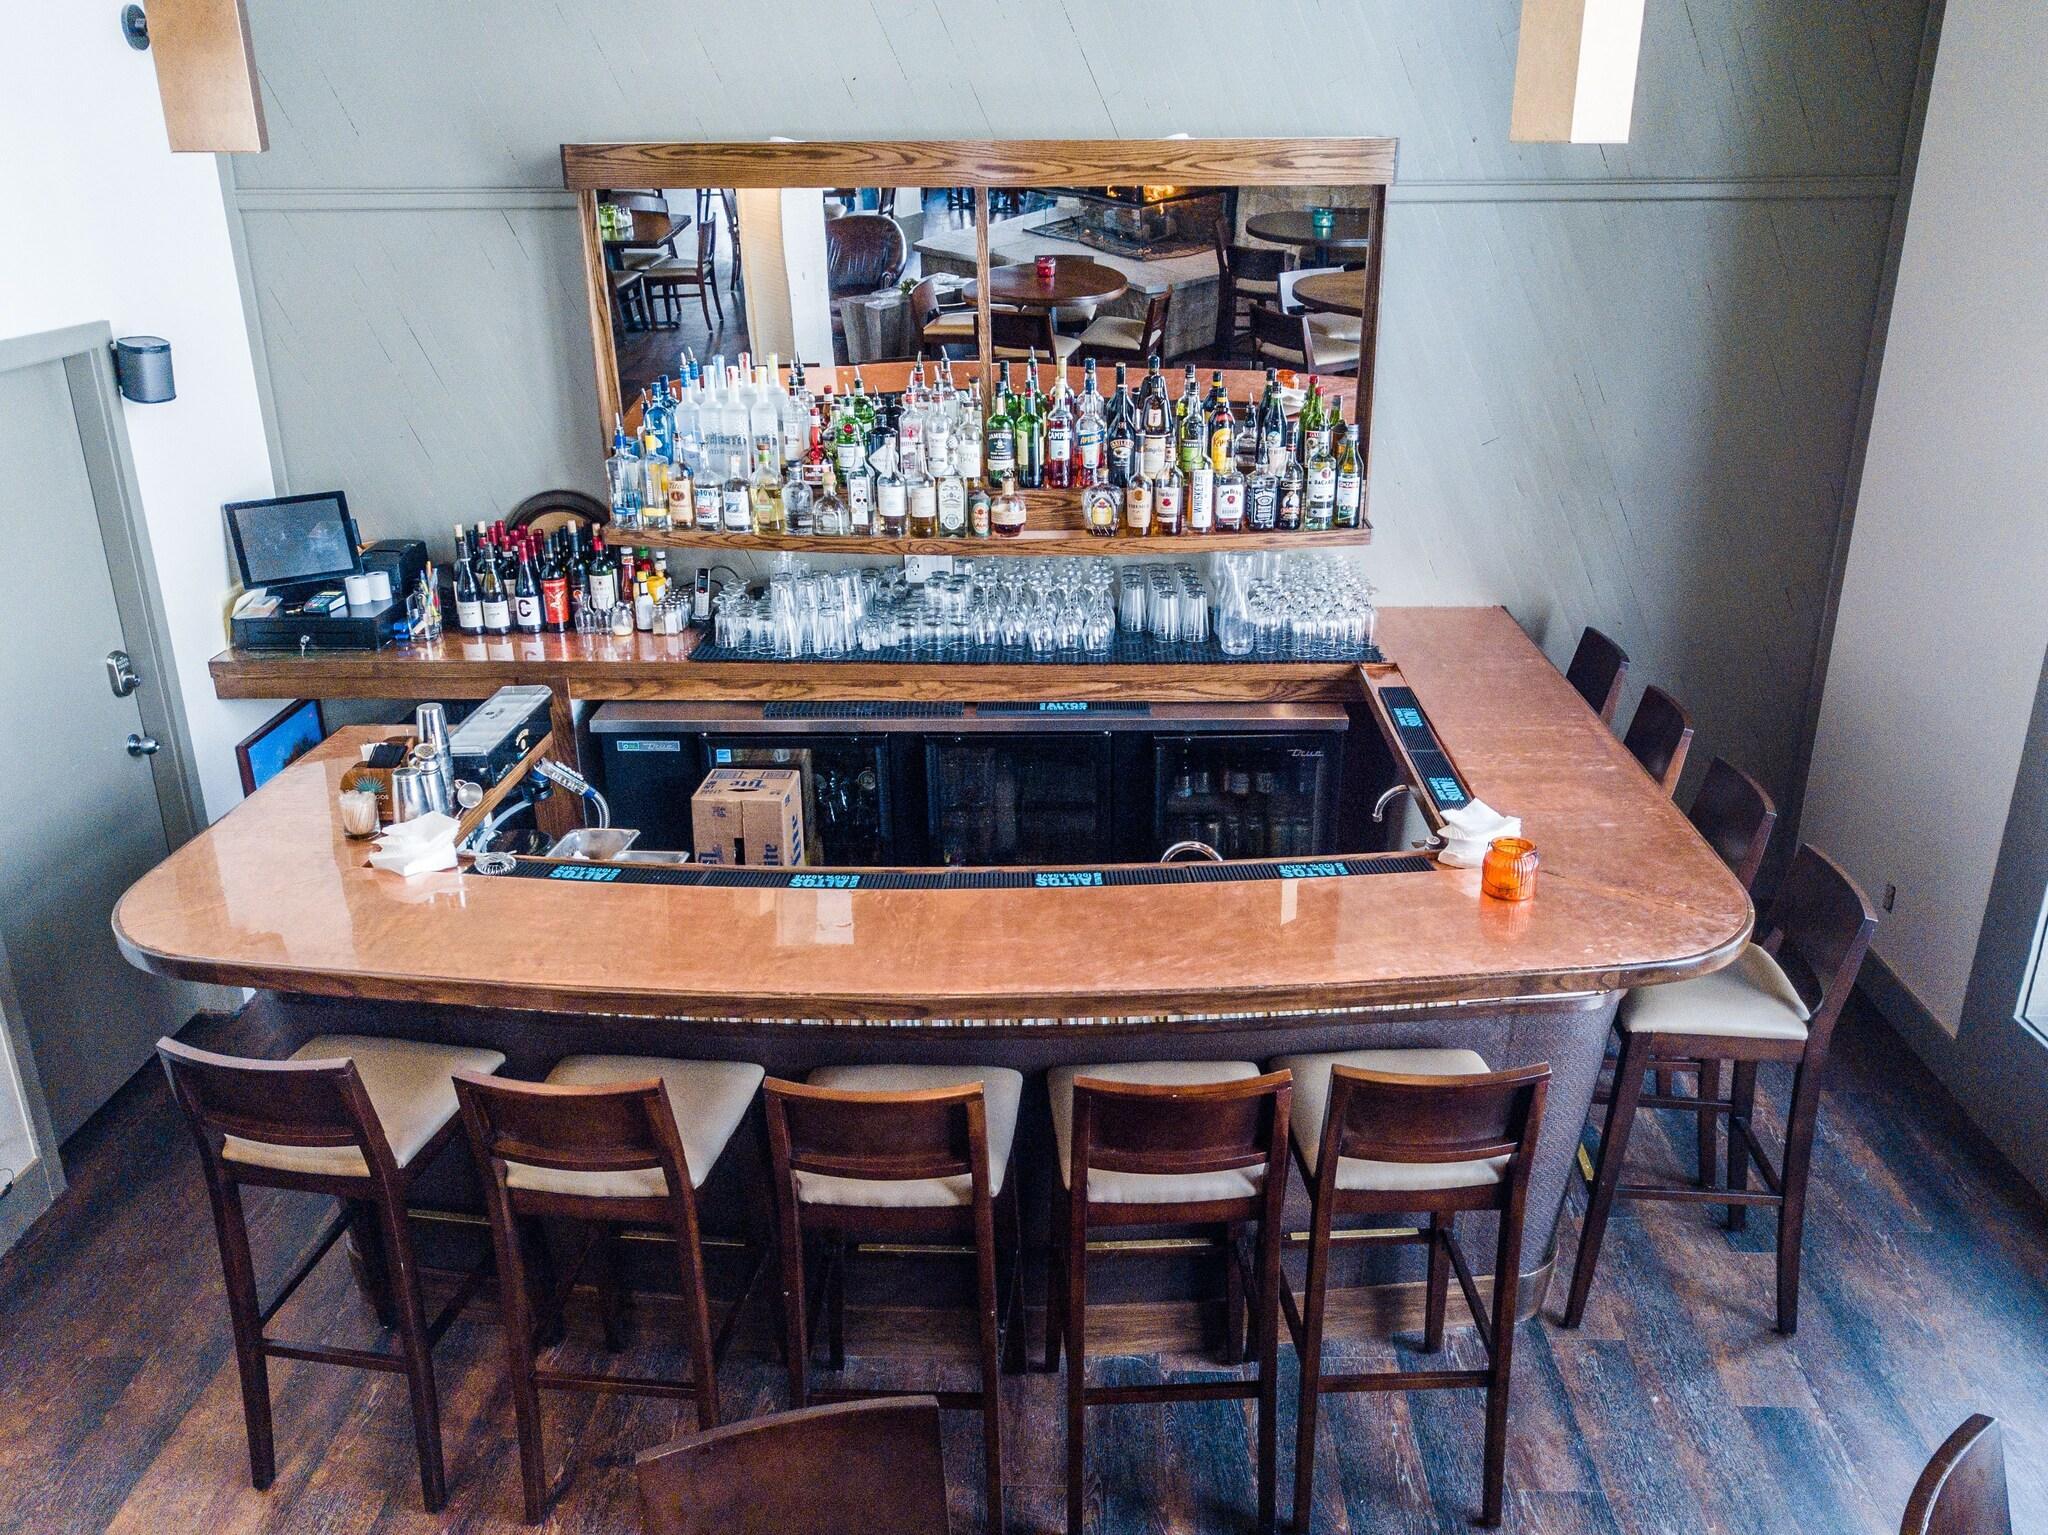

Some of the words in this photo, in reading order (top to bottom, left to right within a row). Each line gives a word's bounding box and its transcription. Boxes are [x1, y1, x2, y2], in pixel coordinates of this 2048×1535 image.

[549, 868, 607, 881] ALTOS
[1279, 866, 1337, 878] ALTOS
[788, 878, 849, 888] ALTOS
[1035, 877, 1092, 887] ALTOS
